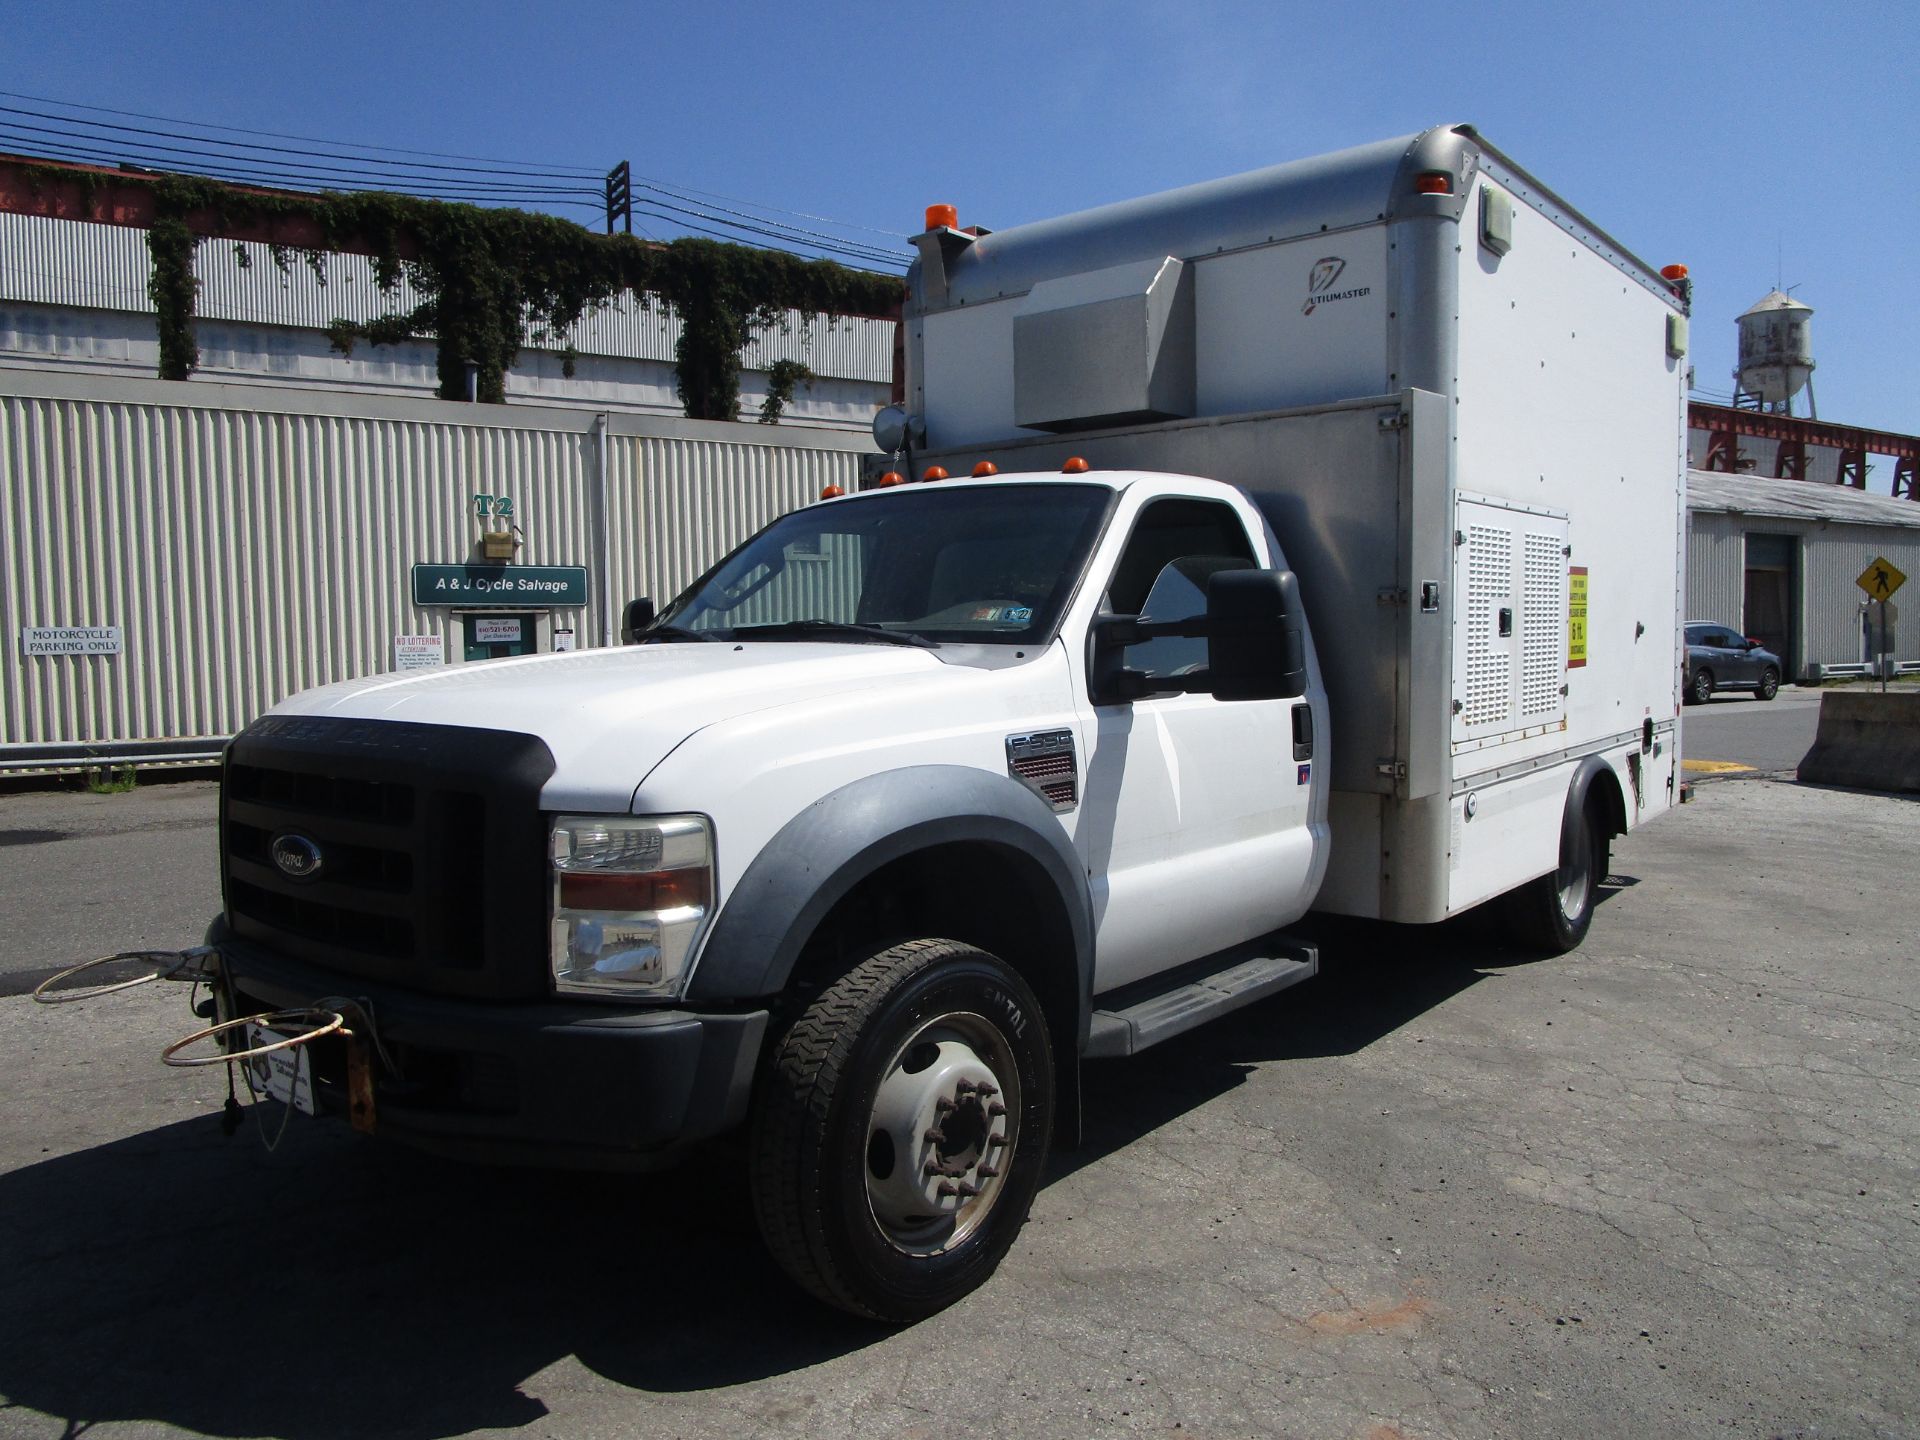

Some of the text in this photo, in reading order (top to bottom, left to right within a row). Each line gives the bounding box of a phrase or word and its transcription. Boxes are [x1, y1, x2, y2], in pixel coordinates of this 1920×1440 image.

[1310, 287, 1371, 304] UTILIMASTER
[435, 577, 568, 593] A & J Cycle Salvage
[33, 630, 113, 640] MOTORCYCLE
[30, 641, 118, 652] PARKING ONLY
[396, 636, 441, 646] NO LOITERING
